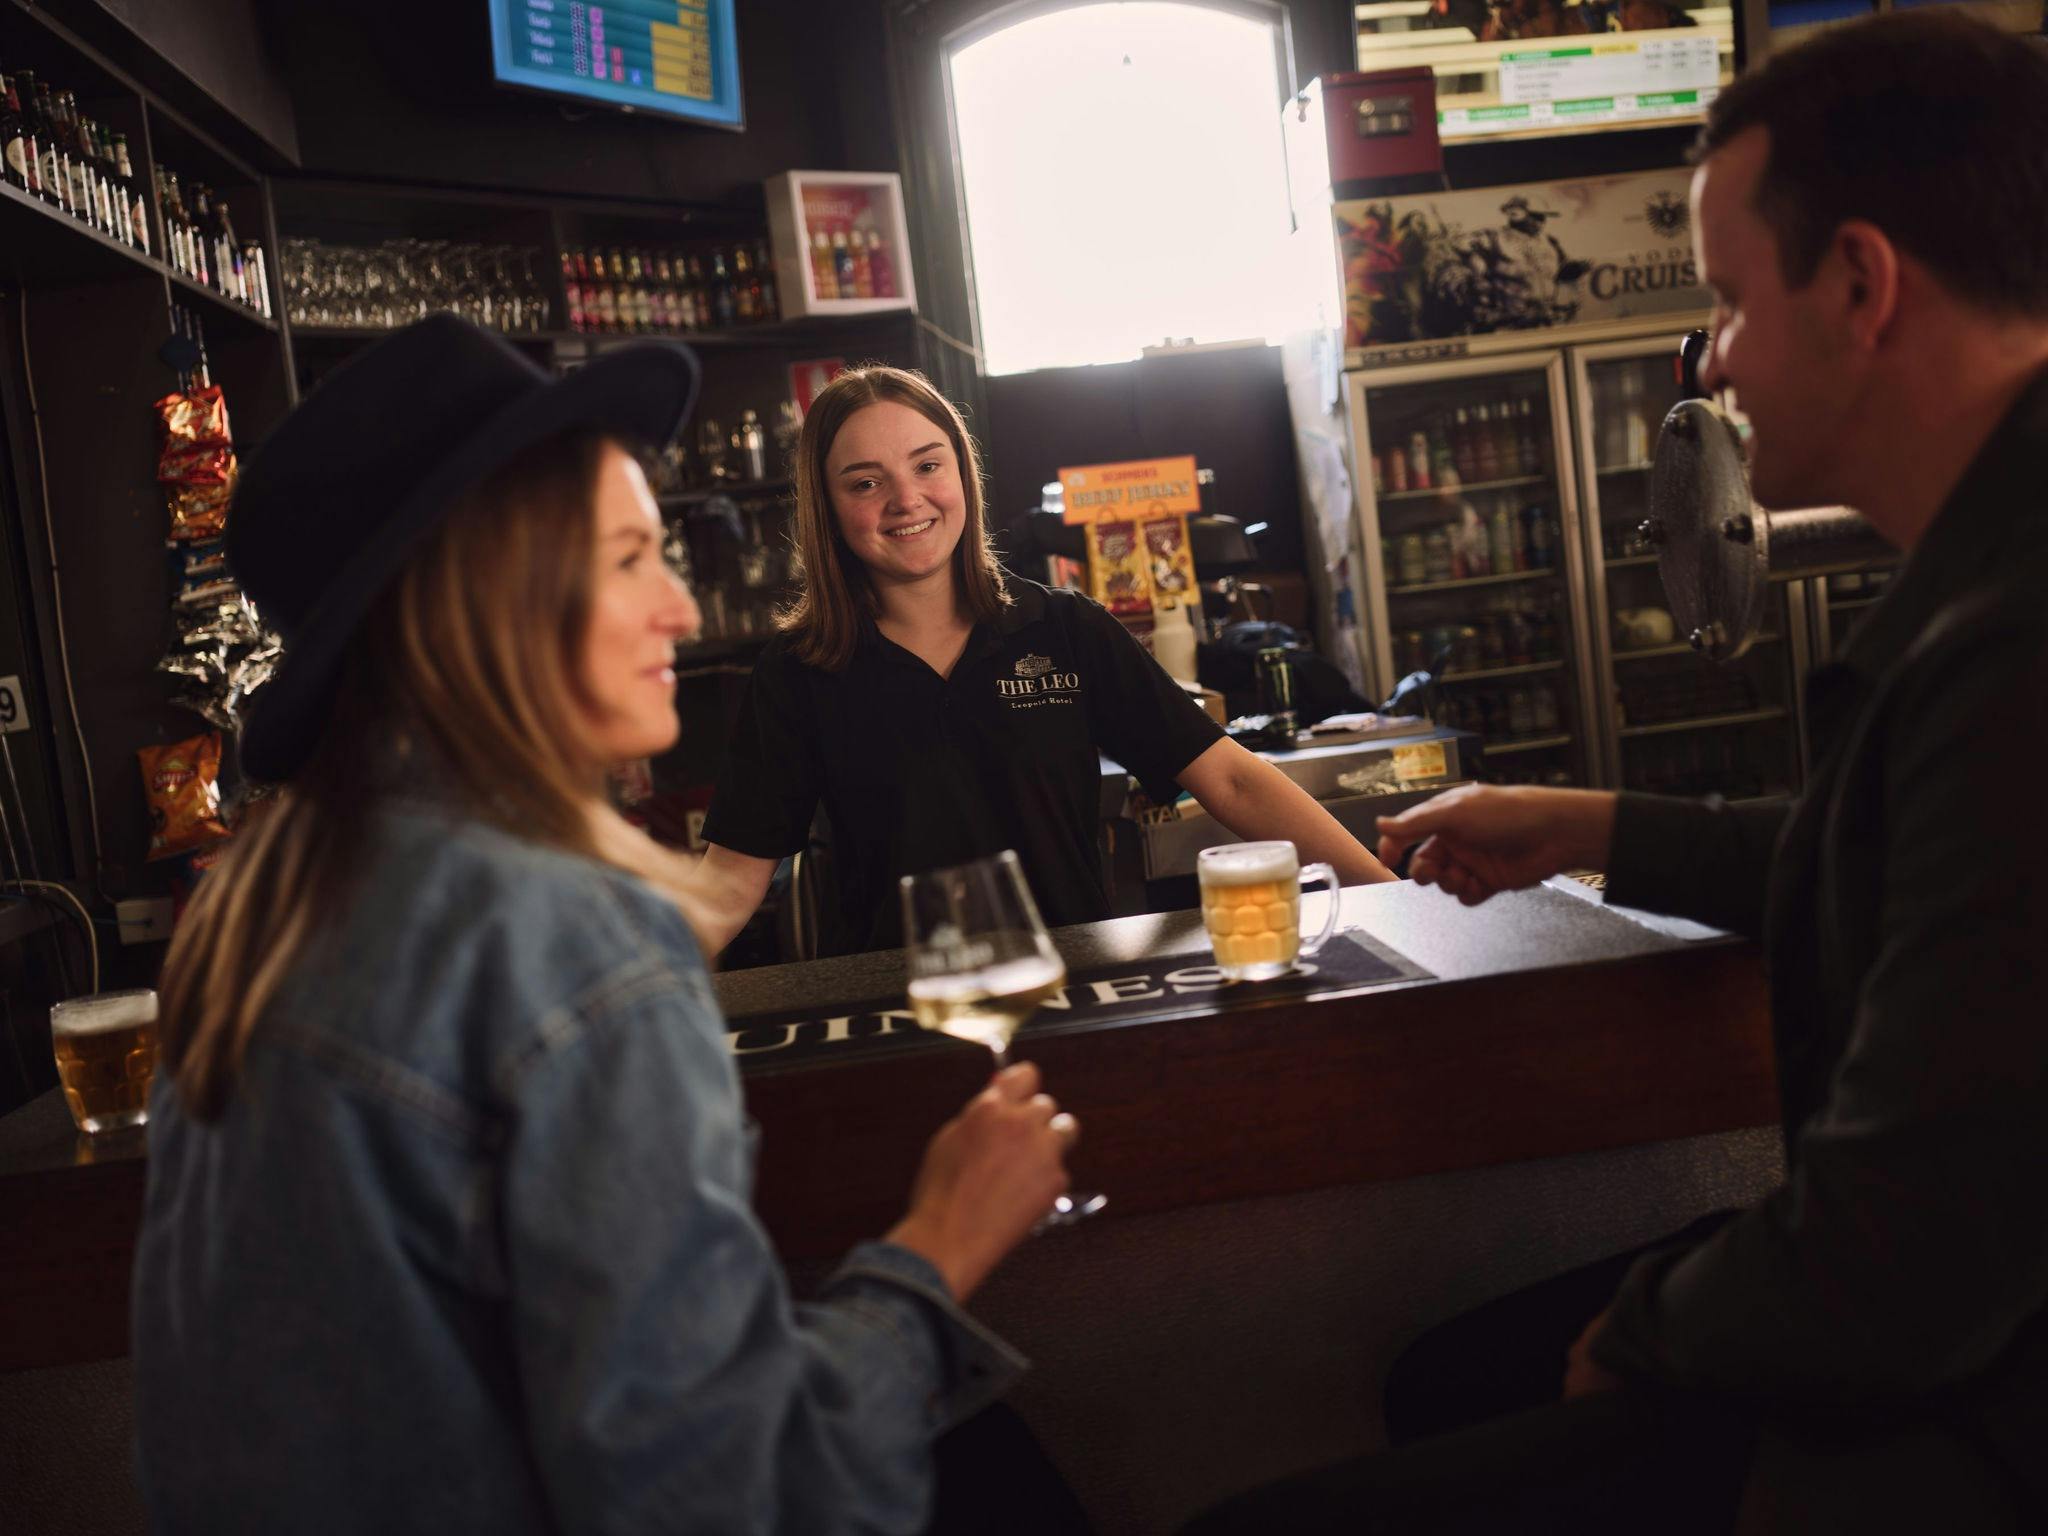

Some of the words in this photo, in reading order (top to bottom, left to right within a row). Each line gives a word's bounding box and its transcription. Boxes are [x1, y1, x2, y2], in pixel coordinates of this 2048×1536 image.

[1590, 262, 1699, 300] CRUIS
[997, 679, 1039, 695] THE
[1041, 672, 1079, 690] LEO
